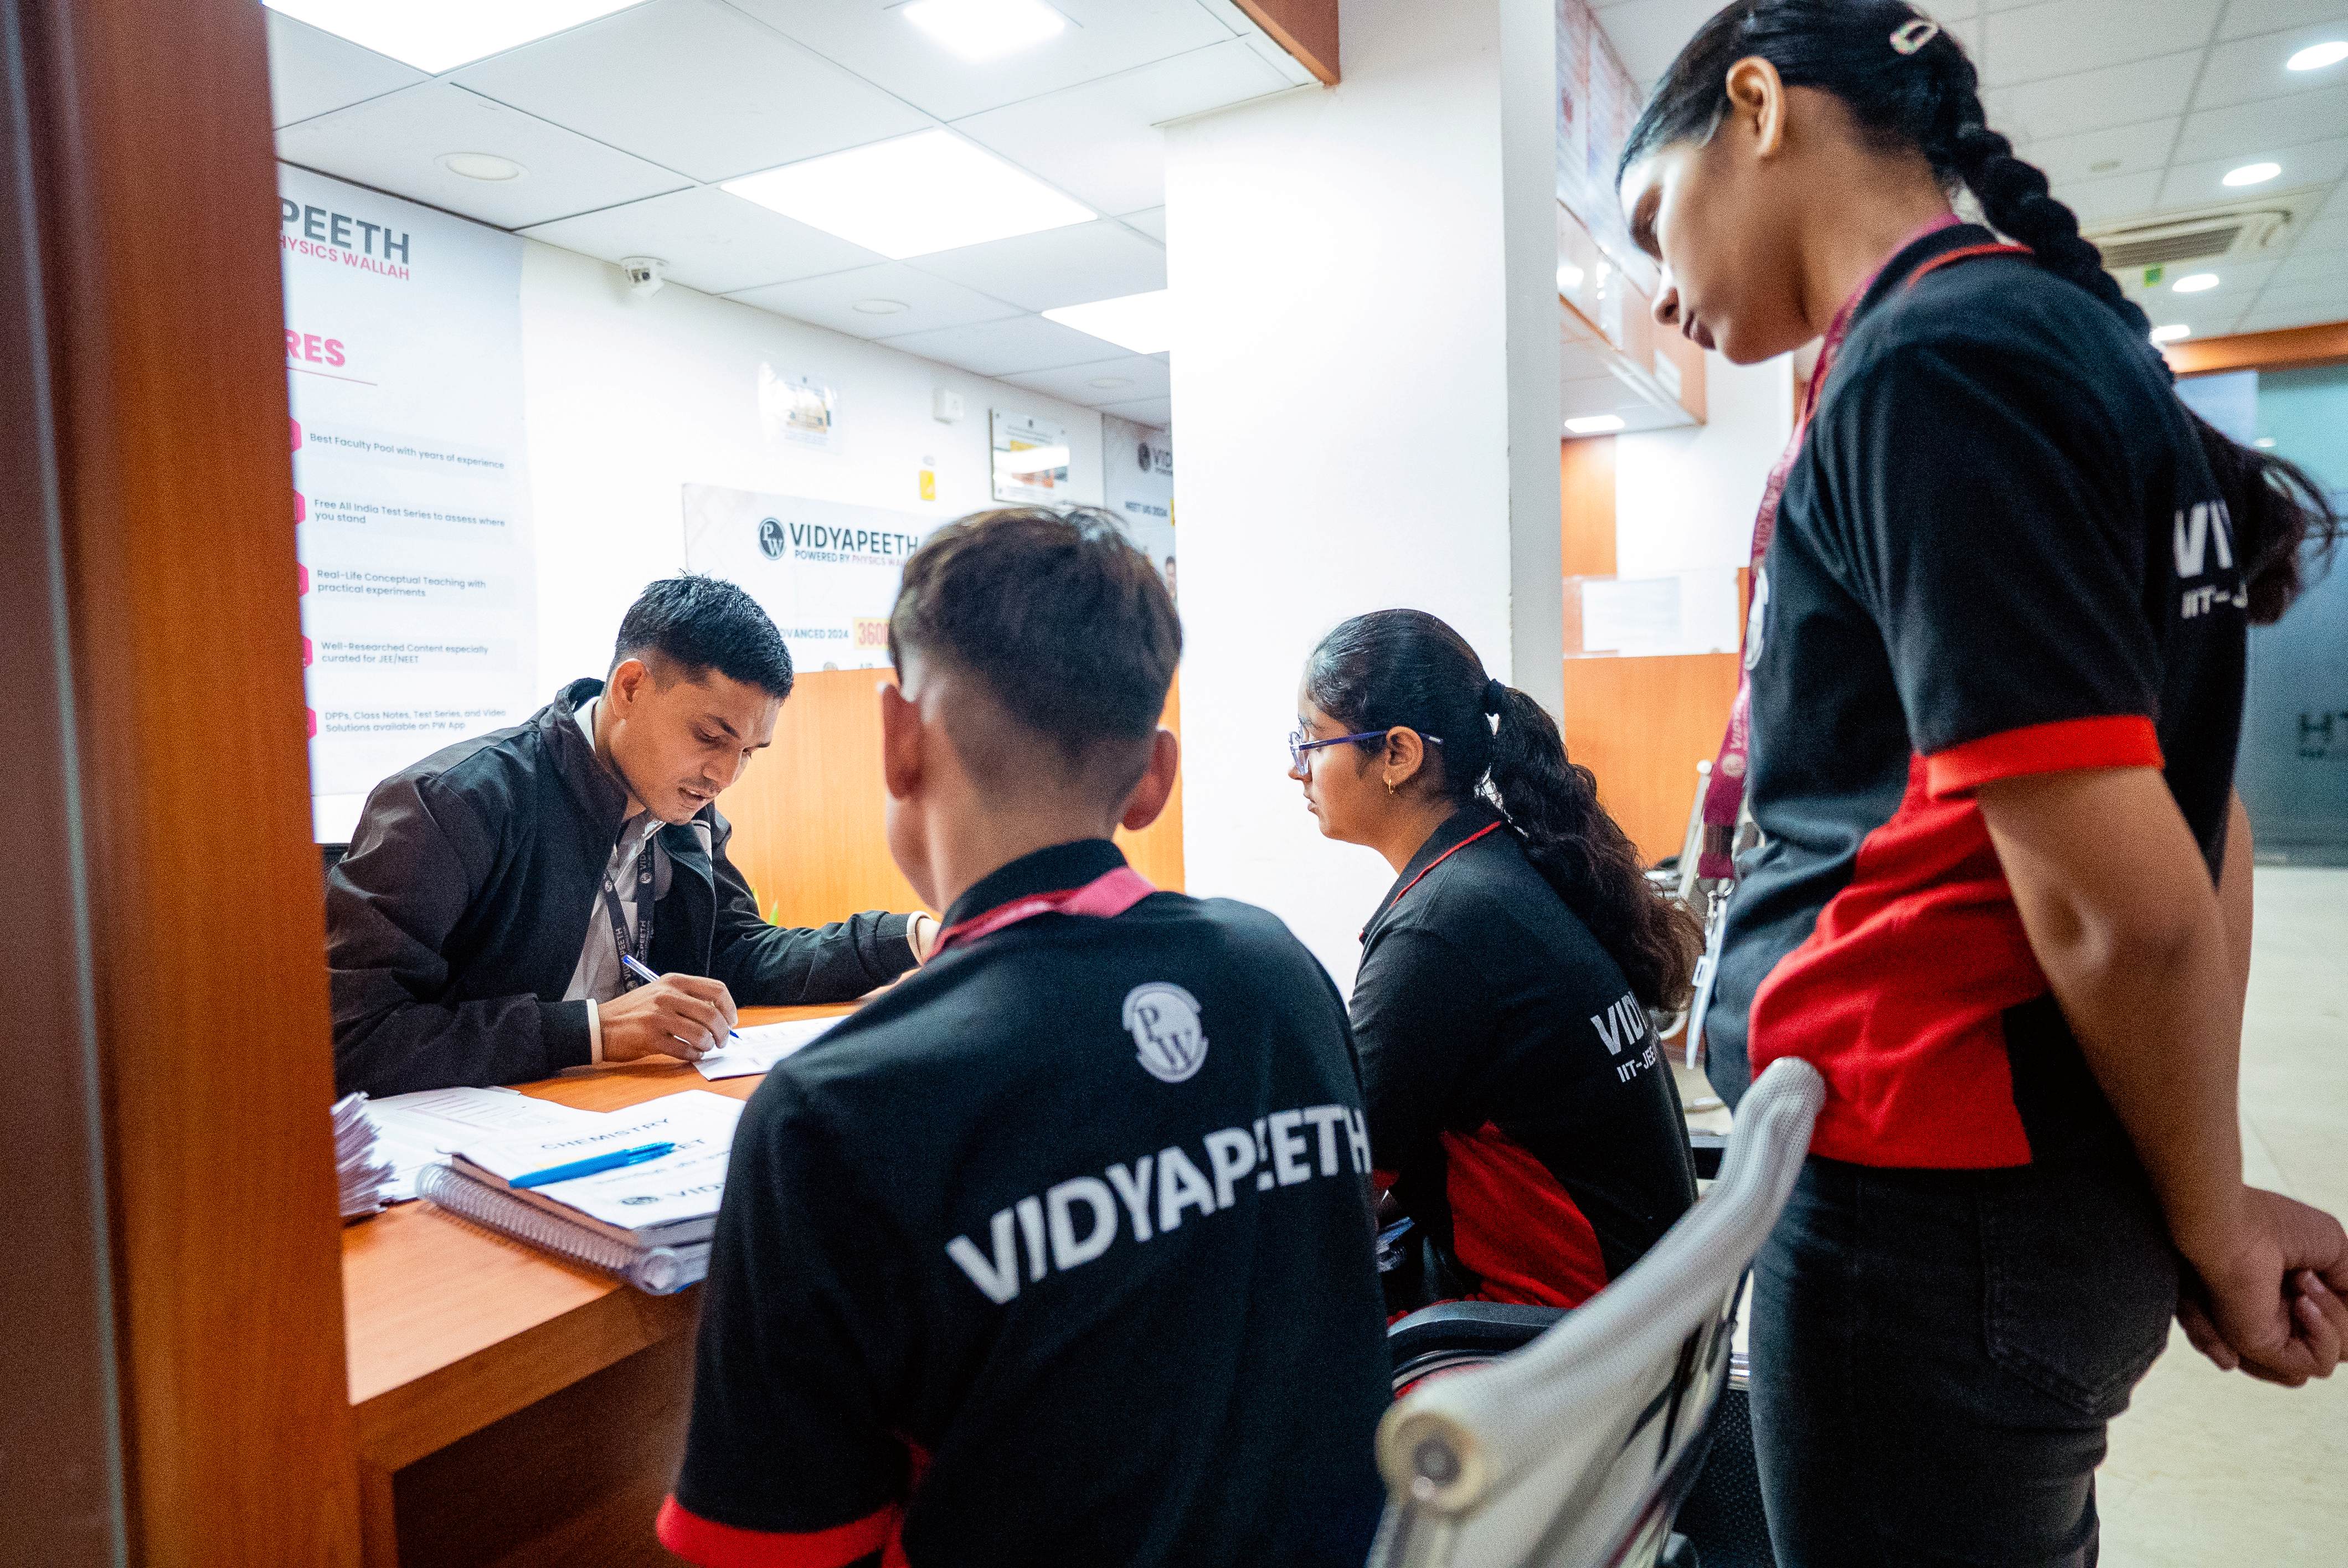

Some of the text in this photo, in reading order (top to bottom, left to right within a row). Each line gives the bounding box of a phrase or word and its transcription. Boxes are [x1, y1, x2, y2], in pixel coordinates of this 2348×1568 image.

[343, 252, 409, 281] WALLAH
[310, 433, 504, 469] Best Faculty Pool with years of experience
[315, 499, 505, 527] Free All India Test Series to assess where
[315, 513, 366, 524] you stand
[789, 522, 918, 556] VIDYAPEETH
[2173, 500, 2233, 578] VI
[795, 550, 838, 562] POWERED
[840, 553, 851, 563] BY
[852, 555, 885, 565] PHYSICS
[317, 570, 486, 590] Real-Life Conceptual Teaching with
[318, 583, 426, 598] practical experiments
[828, 628, 848, 639] 2024
[321, 641, 488, 655] Well-Researched Content especially
[322, 653, 419, 665] curated for JEE/NEET
[326, 710, 351, 721] DPPs,
[354, 711, 380, 720] Class
[414, 709, 432, 719] Test
[465, 709, 481, 718] and
[482, 708, 506, 718] Video
[326, 723, 370, 733] Solutions
[373, 721, 416, 731] available
[432, 721, 447, 730] PW
[449, 721, 466, 731] App
[615, 927, 631, 981] VIDPEETH
[1131, 995, 1201, 1075] PW
[540, 1118, 669, 1150] CHEMISTRY
[671, 1138, 705, 1152] ET
